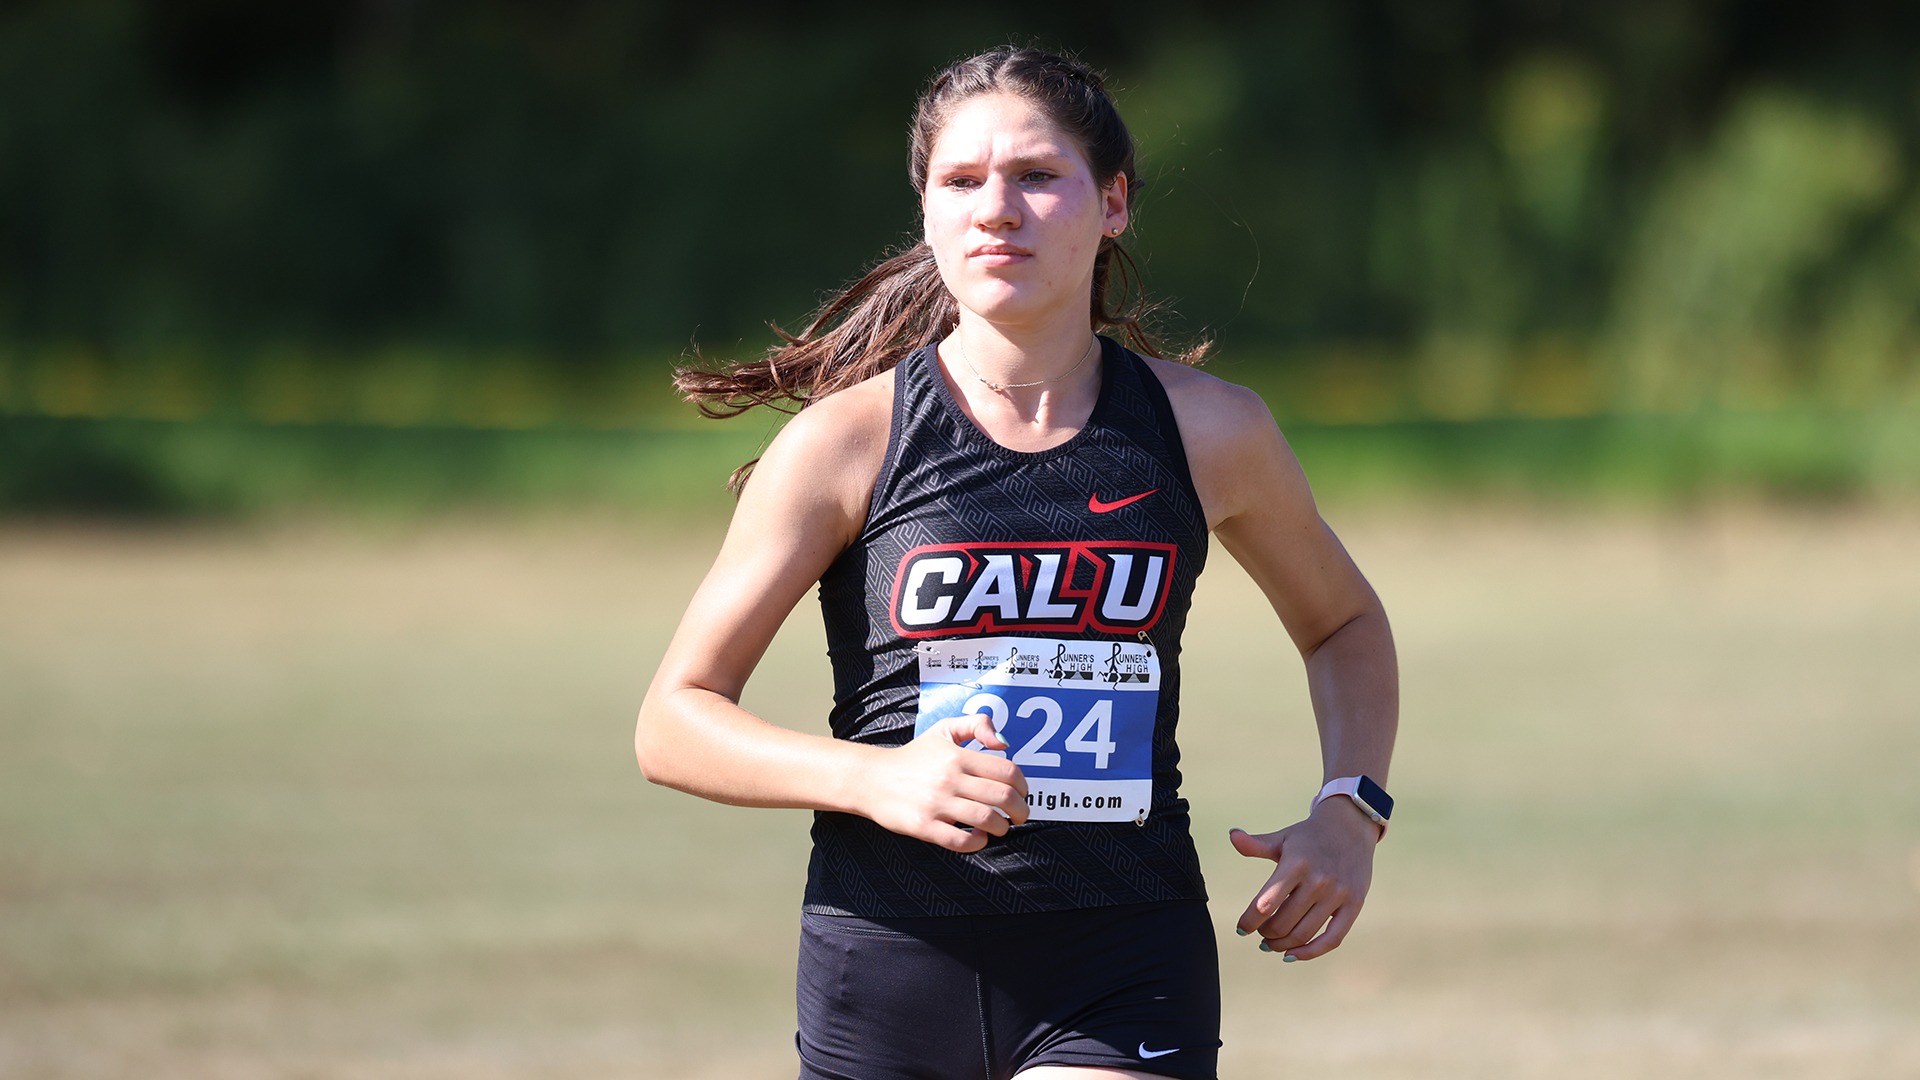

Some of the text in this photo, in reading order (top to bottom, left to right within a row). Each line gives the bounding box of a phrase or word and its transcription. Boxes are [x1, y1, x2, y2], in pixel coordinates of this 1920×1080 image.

[1050, 643, 1095, 664] RUNNER'S
[1070, 663, 1093, 671] HIGH
[1126, 664, 1149, 673] HIGH
[961, 693, 1116, 770] 224
